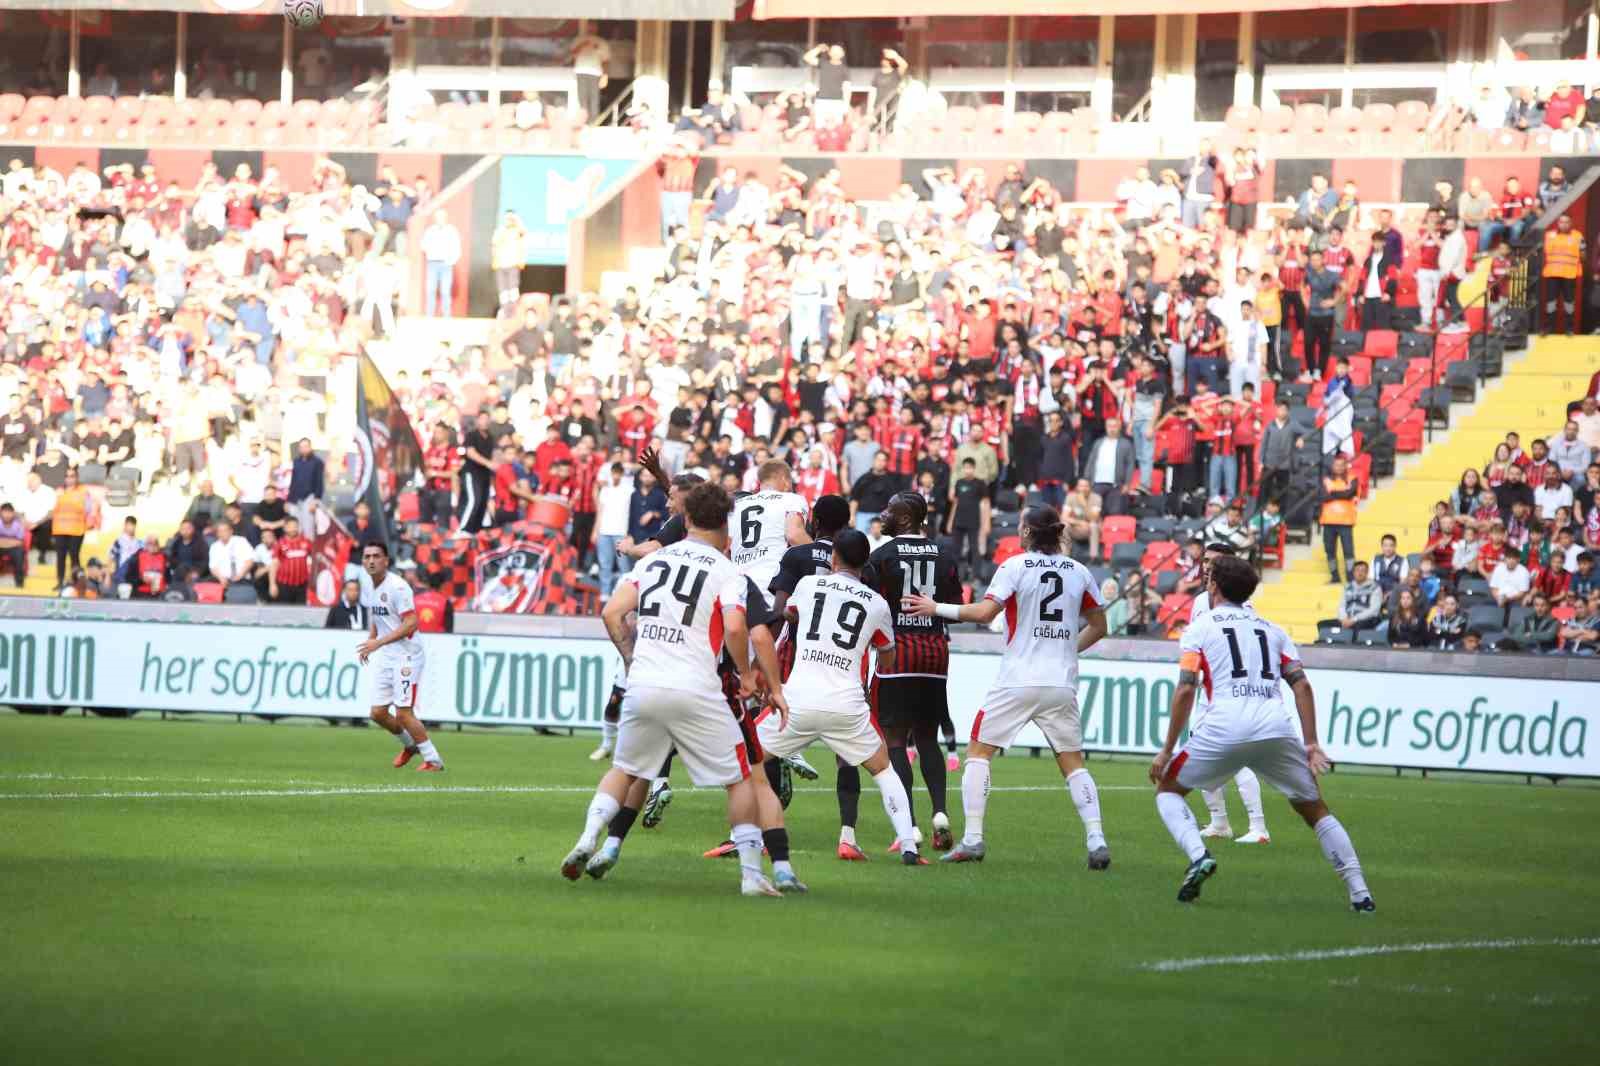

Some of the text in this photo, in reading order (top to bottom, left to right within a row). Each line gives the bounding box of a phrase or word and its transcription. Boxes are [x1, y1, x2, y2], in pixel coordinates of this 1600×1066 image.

[740, 505, 764, 548] 6
[816, 579, 873, 601] BALKAR
[900, 560, 936, 610] 14
[1024, 559, 1074, 570] BALKAR
[639, 560, 709, 627] 24
[1040, 571, 1063, 622] 2
[641, 625, 686, 645] BORZA
[806, 592, 867, 651] 19
[47, 635, 95, 701] un
[140, 642, 360, 710] her sofrada
[456, 638, 604, 721] özmen
[1222, 627, 1274, 680] 11
[402, 680, 410, 694] 7
[1327, 690, 1588, 766] her sofrada
